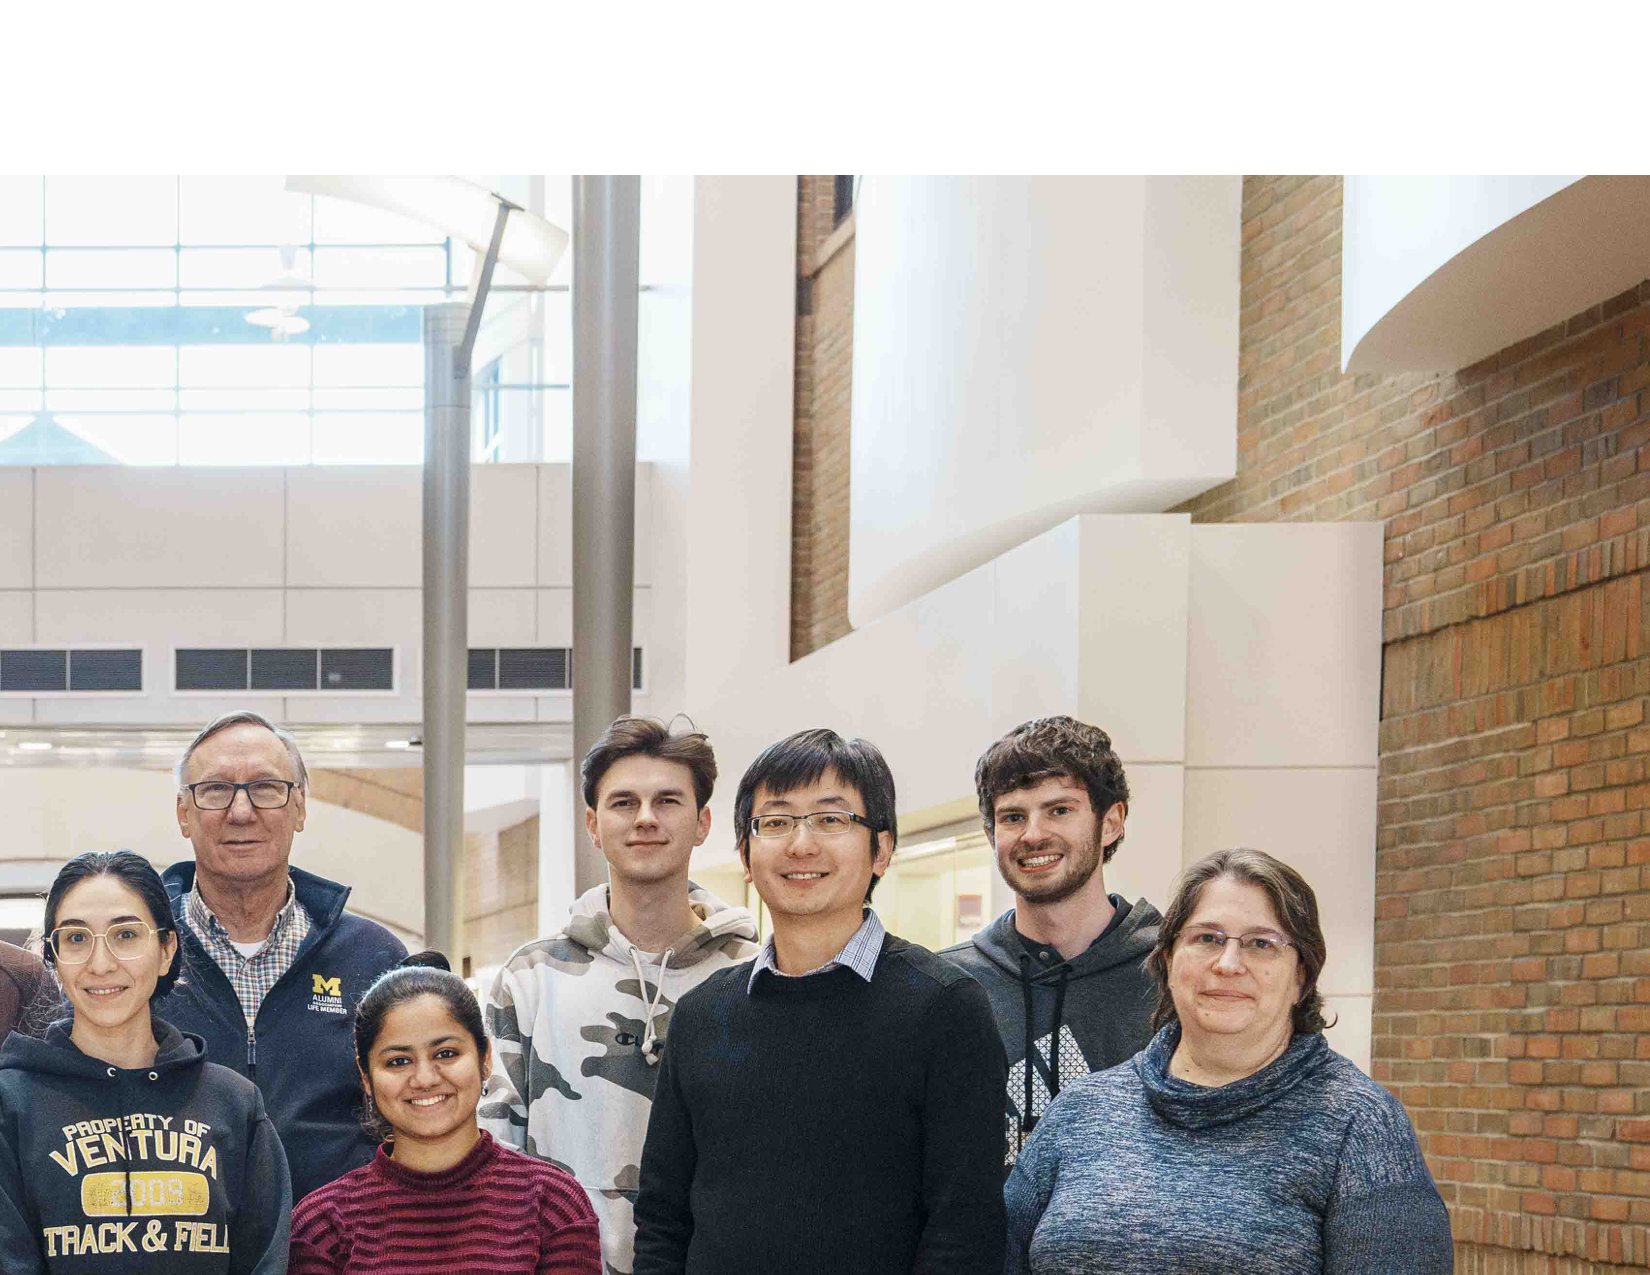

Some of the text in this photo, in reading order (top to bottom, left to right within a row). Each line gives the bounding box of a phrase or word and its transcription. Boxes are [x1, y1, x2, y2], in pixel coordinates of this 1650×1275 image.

[312, 973, 342, 997] M
[307, 1003, 347, 1015] LIFE MEMBER
[312, 994, 342, 1004] ALUMNI
[61, 1113, 211, 1141] PROPERTY OF
[49, 1129, 217, 1180] VENTURA
[43, 1221, 139, 1257] TRACK
[141, 1219, 168, 1252] &
